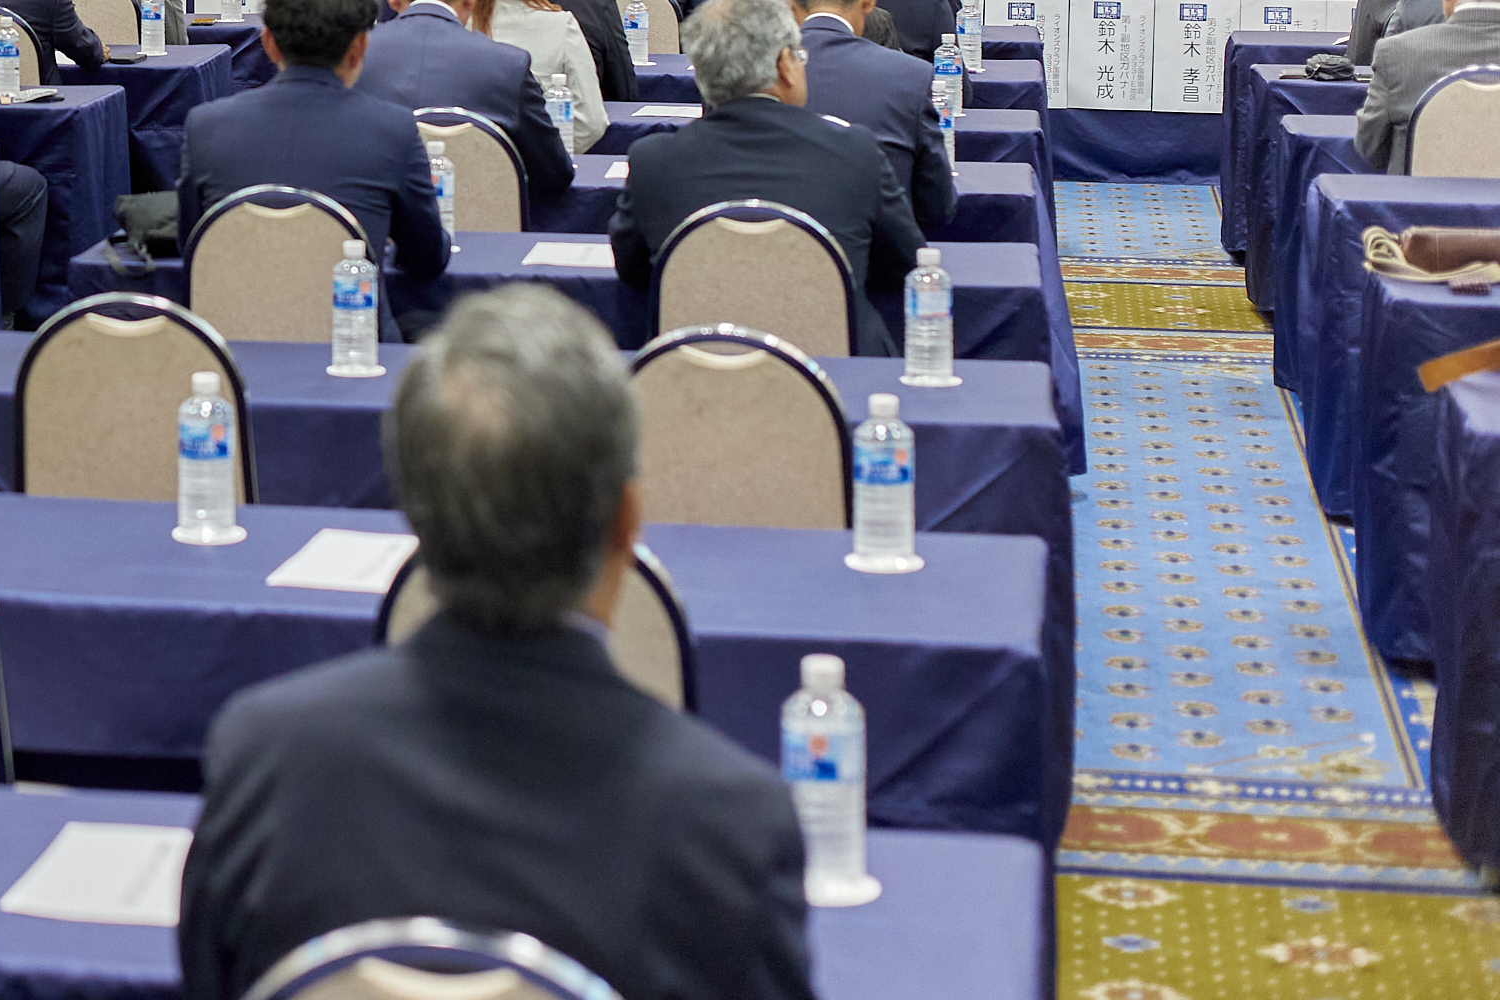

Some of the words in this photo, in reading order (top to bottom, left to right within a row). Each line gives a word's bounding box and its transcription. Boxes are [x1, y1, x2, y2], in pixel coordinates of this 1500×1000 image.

[1097, 20, 1116, 55] 鈴木
[1183, 22, 1202, 58] 鈴木
[1096, 65, 1115, 99] 光成
[1182, 68, 1201, 103] 孝昌
